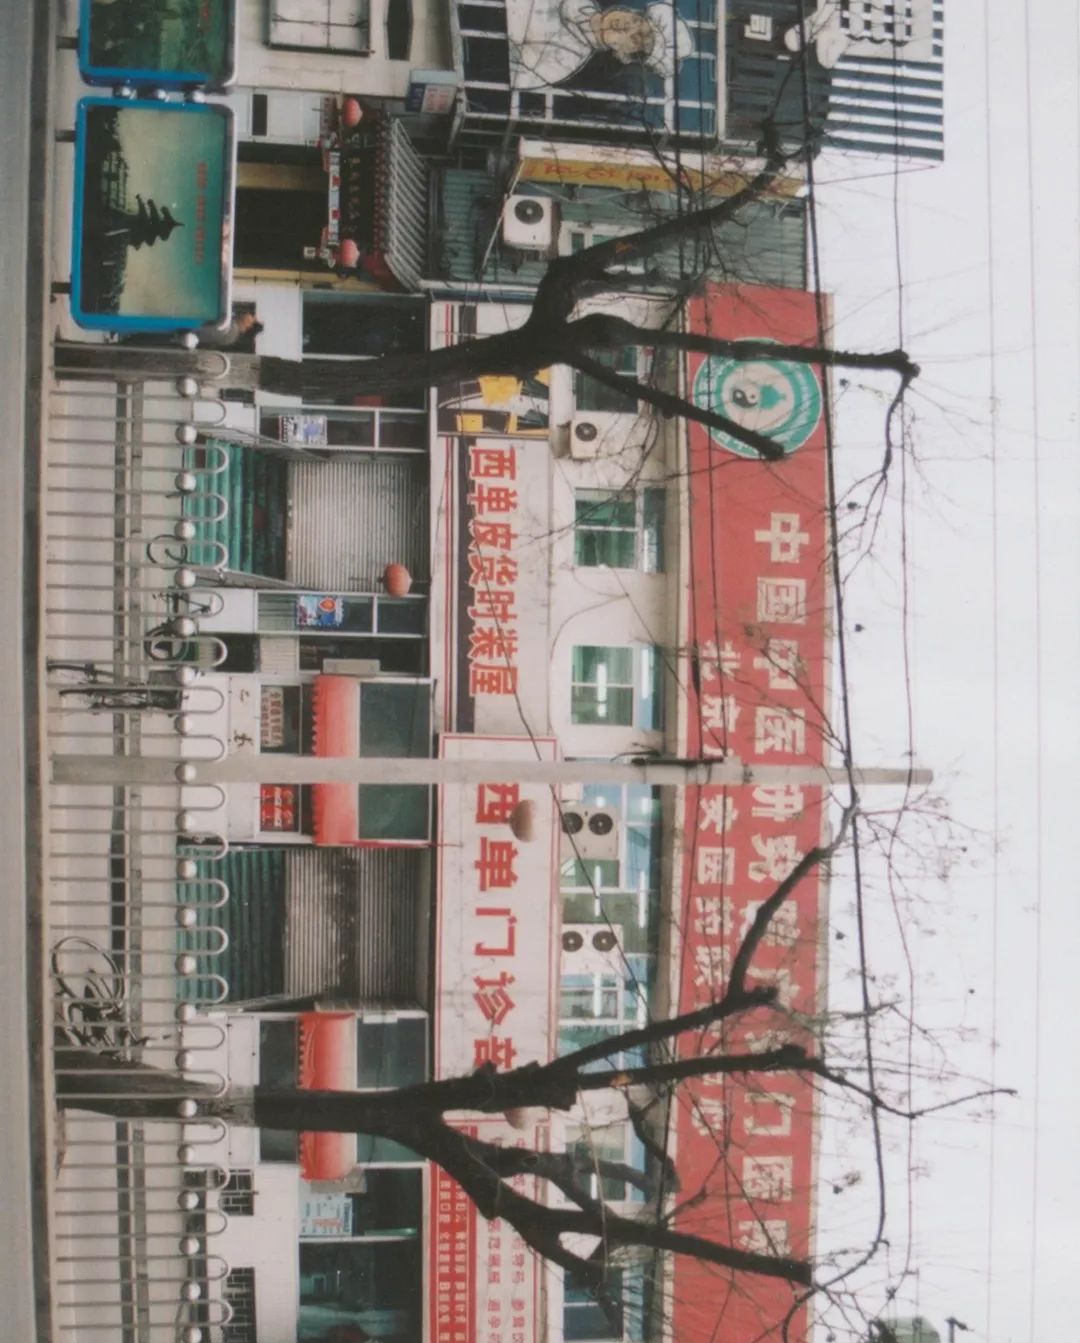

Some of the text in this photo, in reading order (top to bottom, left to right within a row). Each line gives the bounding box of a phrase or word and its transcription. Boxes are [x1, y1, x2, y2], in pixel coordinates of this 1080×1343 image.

[465, 446, 519, 698] 西单皮货时装屋
[472, 783, 520, 1072] 西单门诊部
